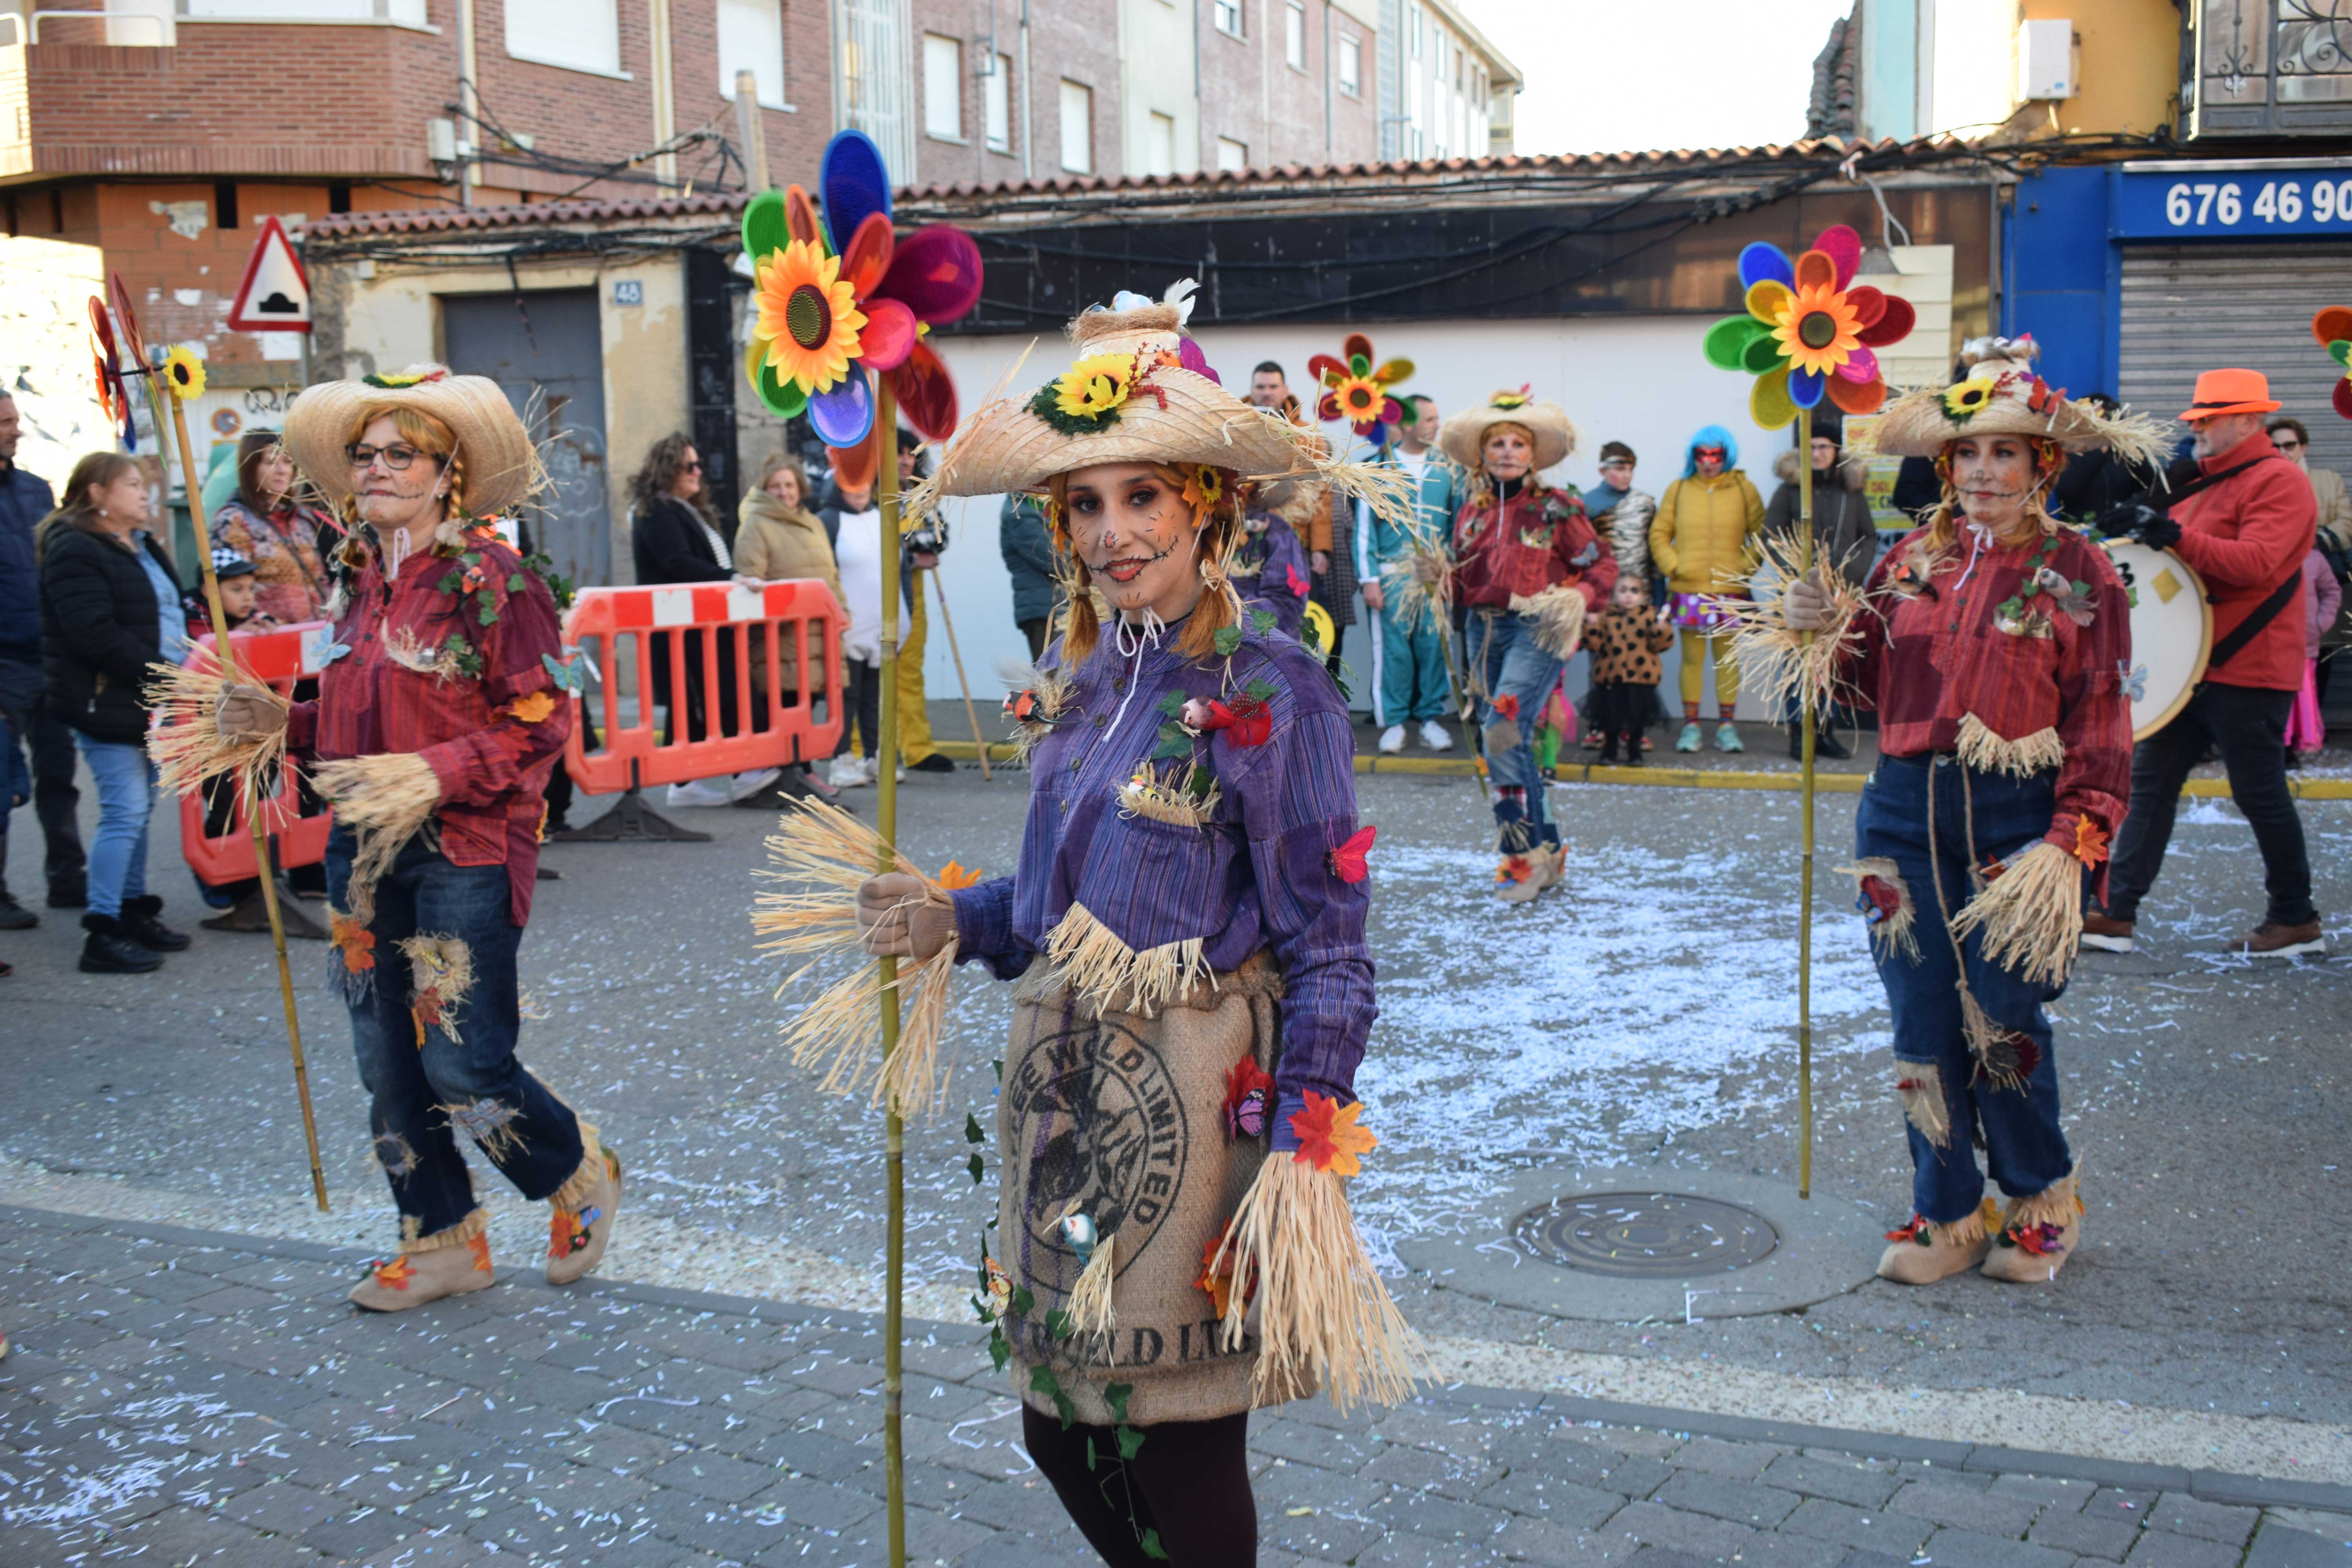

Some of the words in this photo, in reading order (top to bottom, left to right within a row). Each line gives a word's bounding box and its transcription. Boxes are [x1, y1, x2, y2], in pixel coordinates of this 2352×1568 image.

[2166, 183, 2242, 226] 676
[2252, 181, 2303, 223] 46
[2312, 180, 2352, 222] 90
[1134, 1067, 1176, 1224] LIMITED
